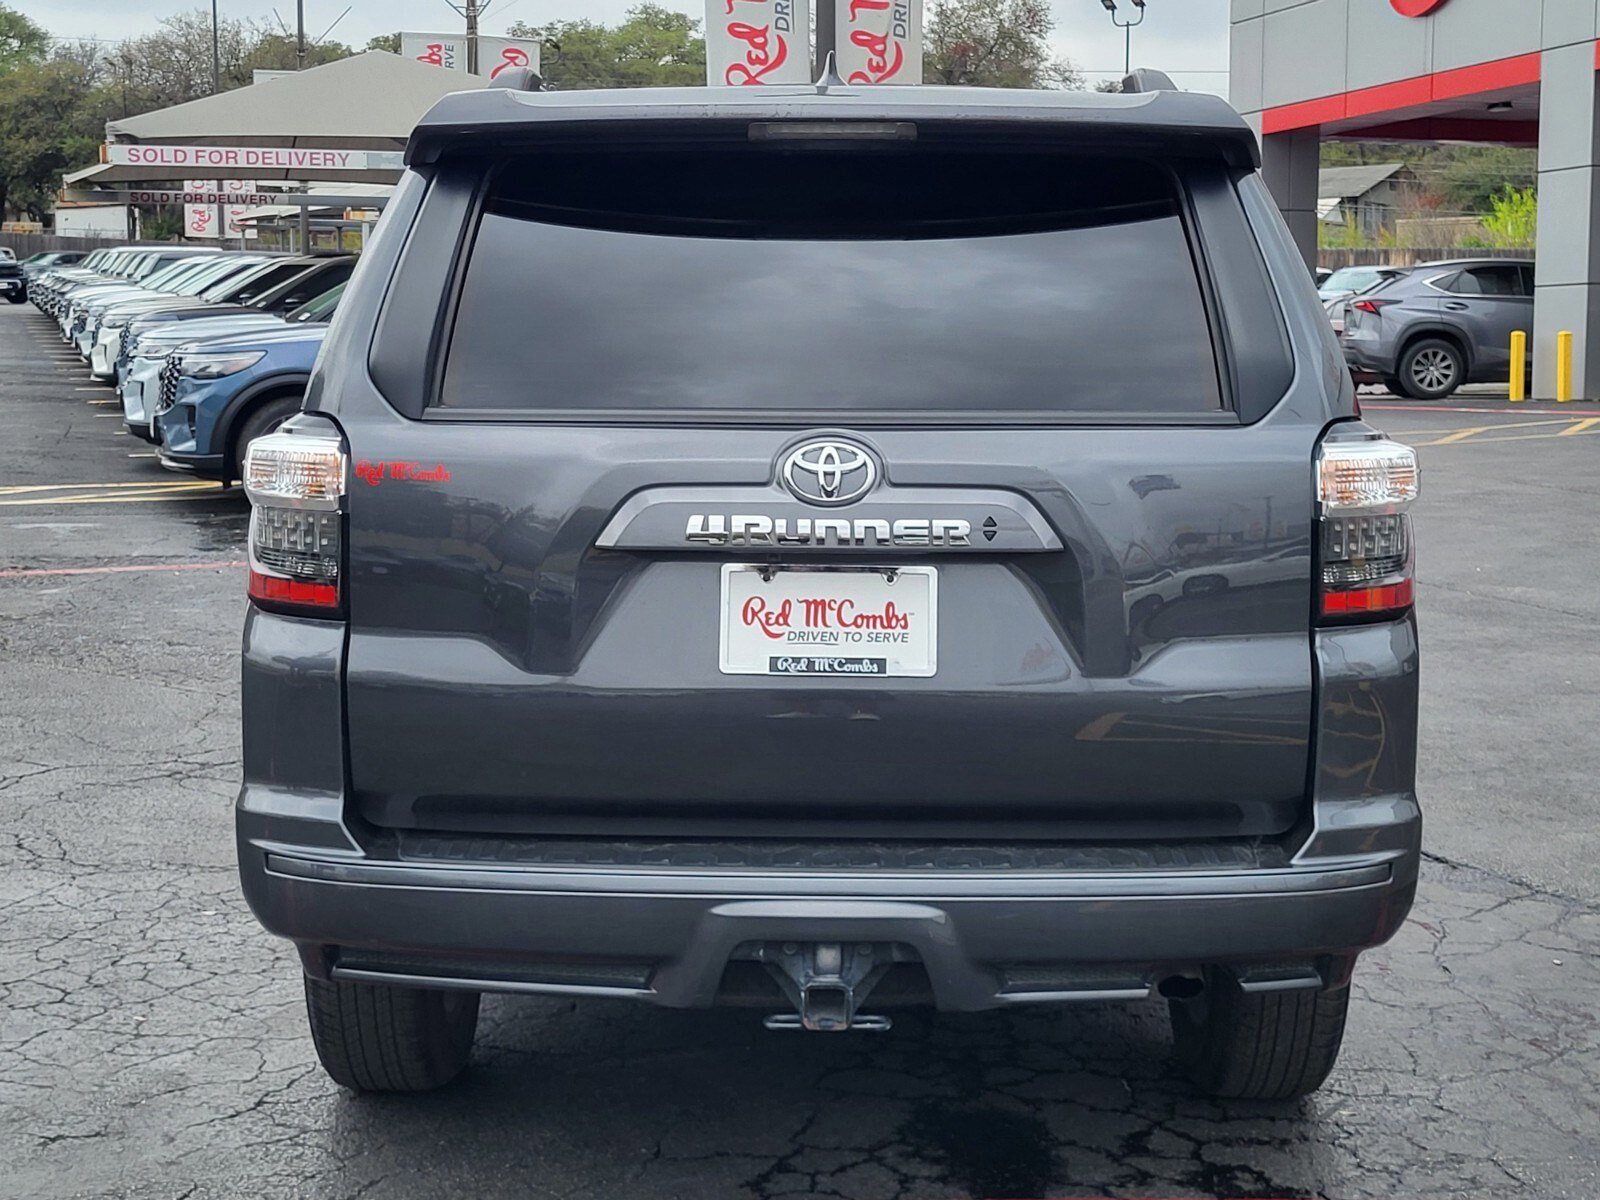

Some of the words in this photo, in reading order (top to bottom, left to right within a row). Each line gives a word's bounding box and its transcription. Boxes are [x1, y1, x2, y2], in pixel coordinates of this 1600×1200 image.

[775, 0, 790, 32] DR
[893, 0, 907, 39] DRI
[127, 148, 187, 163] SOLD
[195, 150, 239, 165] FOR
[246, 151, 351, 167] DELIVERY
[130, 192, 170, 203] SOLD
[174, 193, 204, 204] FOR
[208, 194, 277, 205] DELIVERY
[356, 460, 384, 487] Red
[742, 596, 792, 639] Red
[797, 598, 909, 630] McCombs
[787, 631, 839, 642] DRIVEN
[844, 631, 863, 642] TO
[867, 632, 909, 643] SERVE
[777, 657, 808, 673] Red
[809, 657, 878, 673] McCombs
